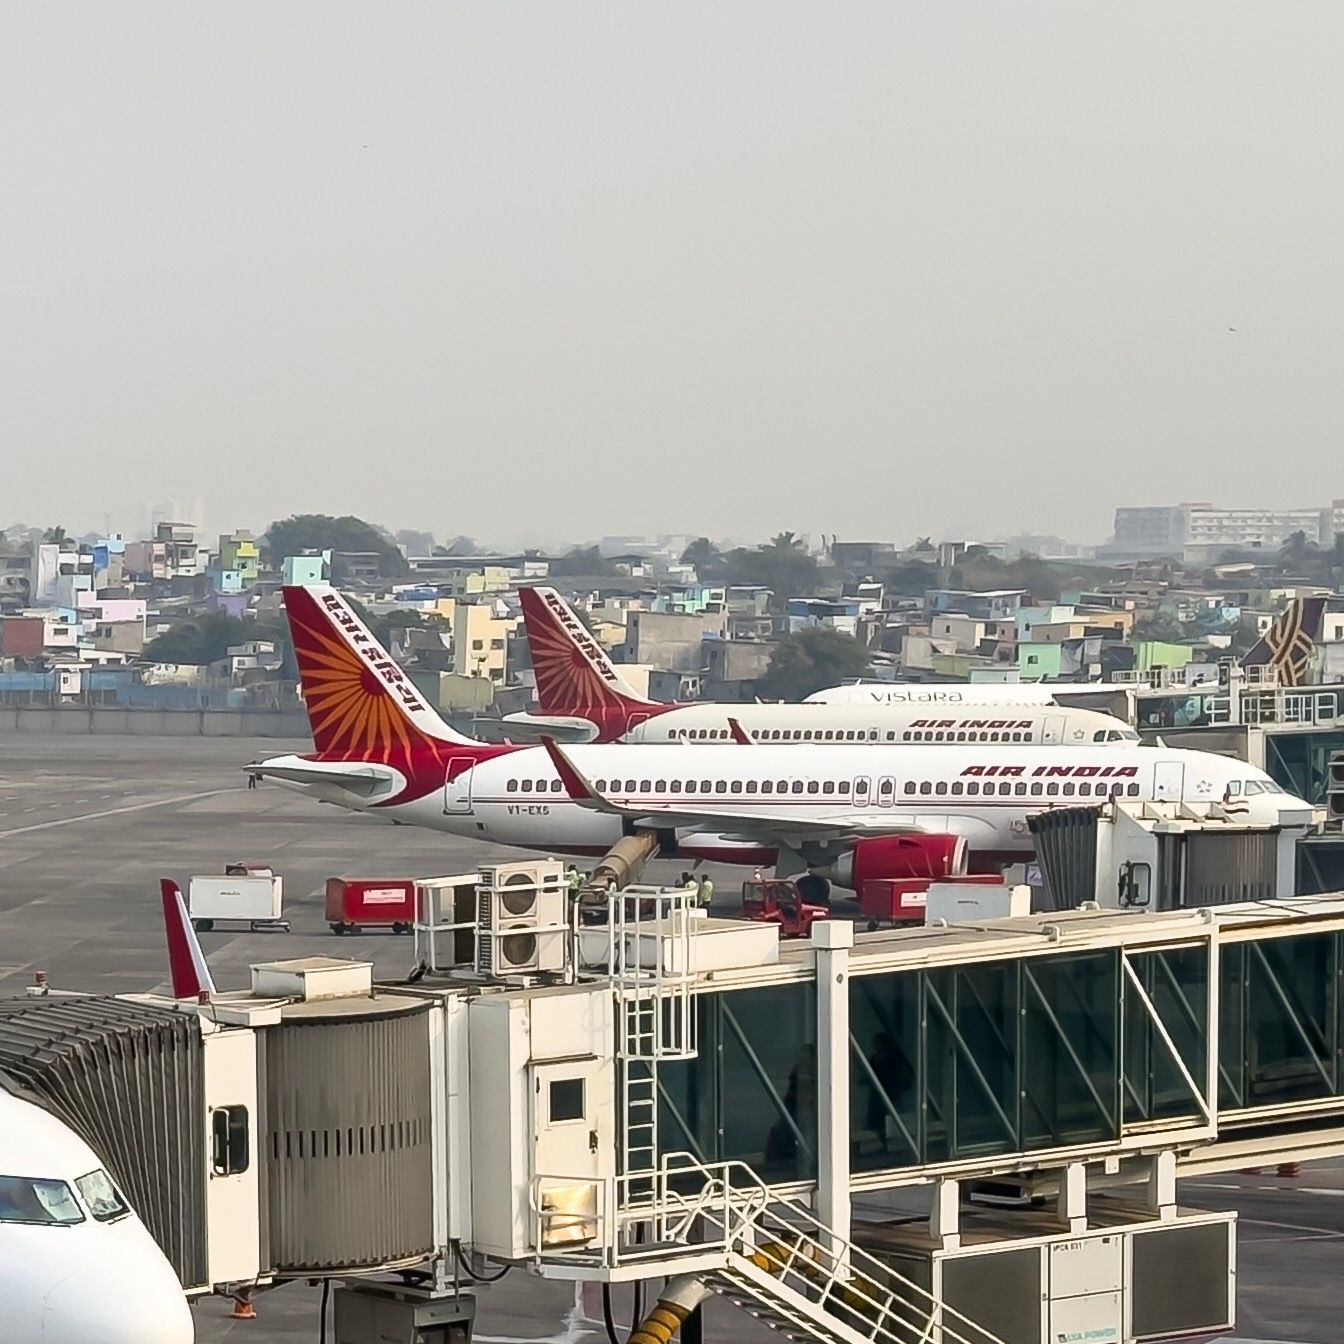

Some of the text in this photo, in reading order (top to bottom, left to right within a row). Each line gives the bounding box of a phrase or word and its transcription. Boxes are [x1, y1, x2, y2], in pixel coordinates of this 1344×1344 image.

[909, 719, 1033, 729] AIR INDIA
[960, 766, 1139, 778] AIR INDIA
